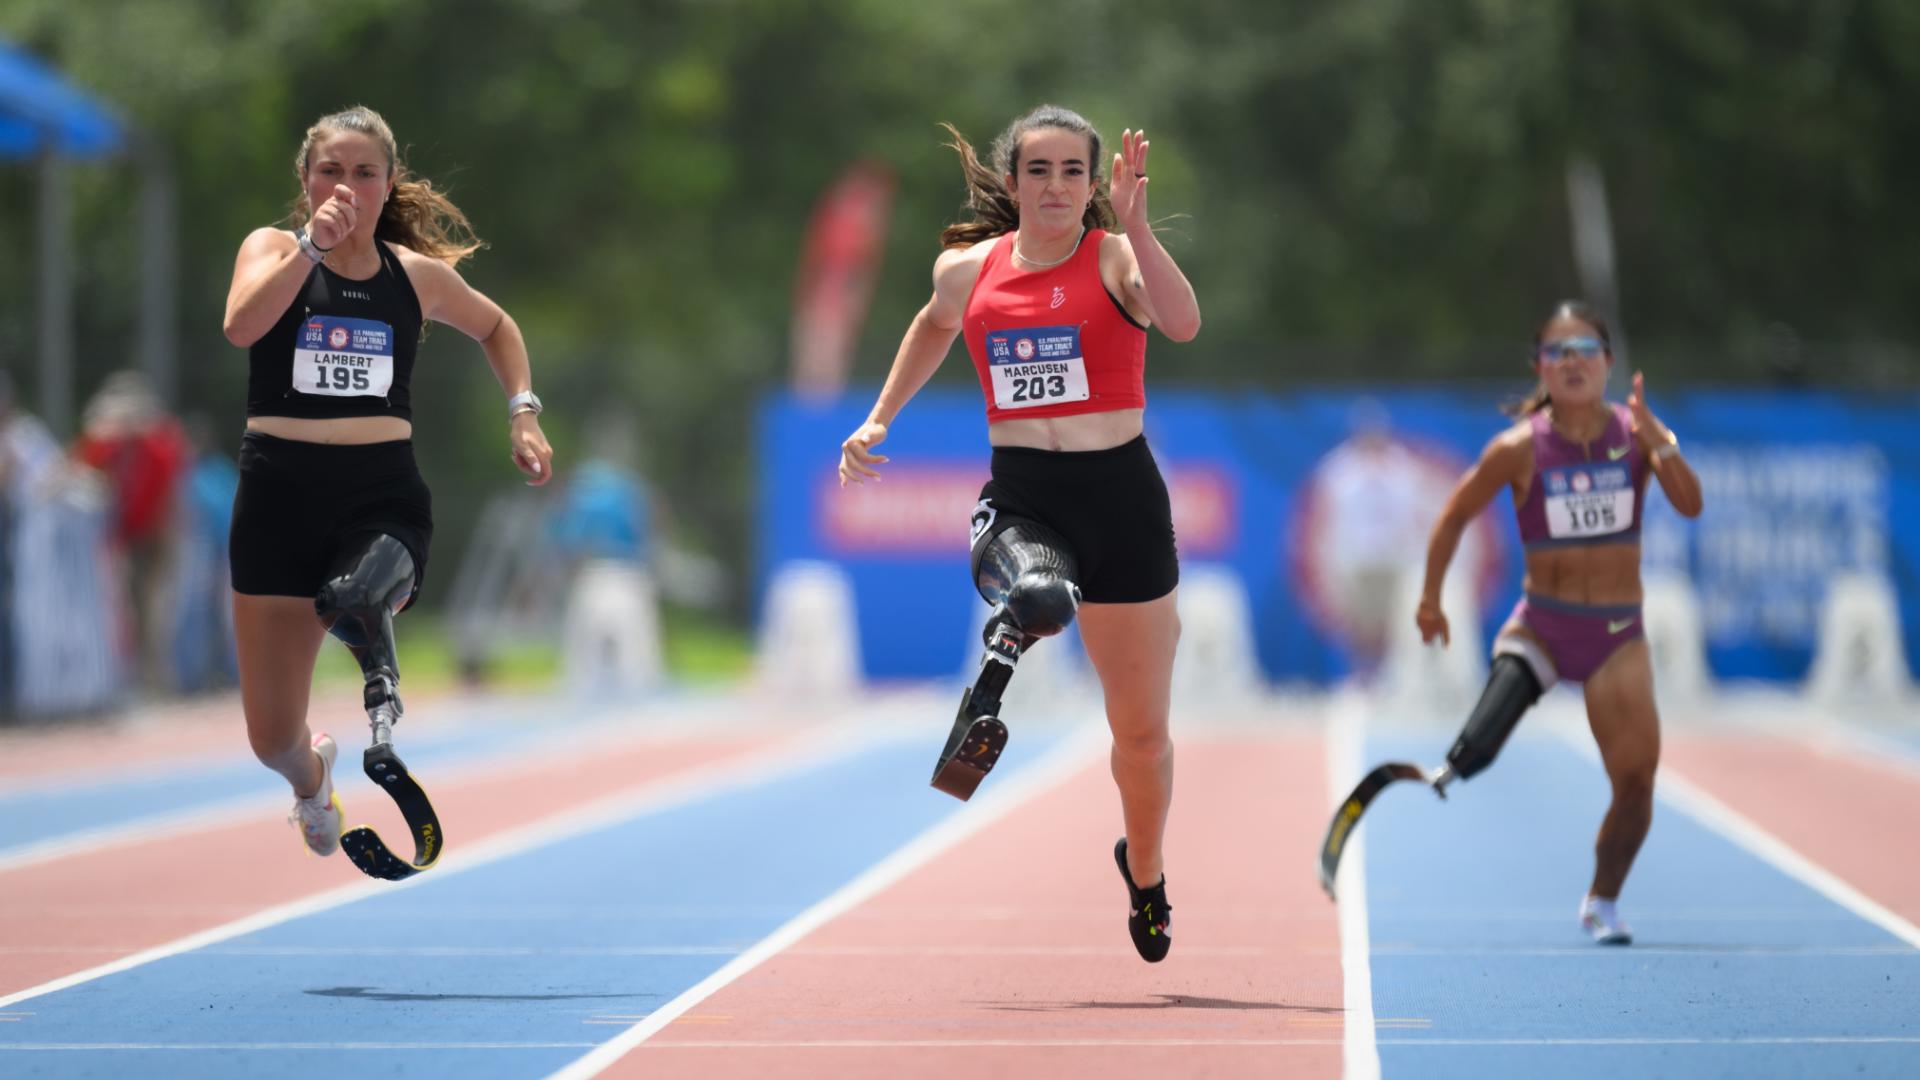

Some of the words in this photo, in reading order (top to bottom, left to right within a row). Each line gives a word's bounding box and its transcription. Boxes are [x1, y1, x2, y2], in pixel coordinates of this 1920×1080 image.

[306, 333, 322, 342] USA
[353, 336, 367, 344] TEAM
[369, 337, 386, 346] TRIALS
[993, 347, 1010, 356] USA
[314, 354, 374, 368] LAMBERT
[1004, 363, 1068, 377] MARCUSEN
[316, 366, 370, 390] 195
[1013, 376, 1066, 402] 203
[1570, 508, 1616, 530] 105
